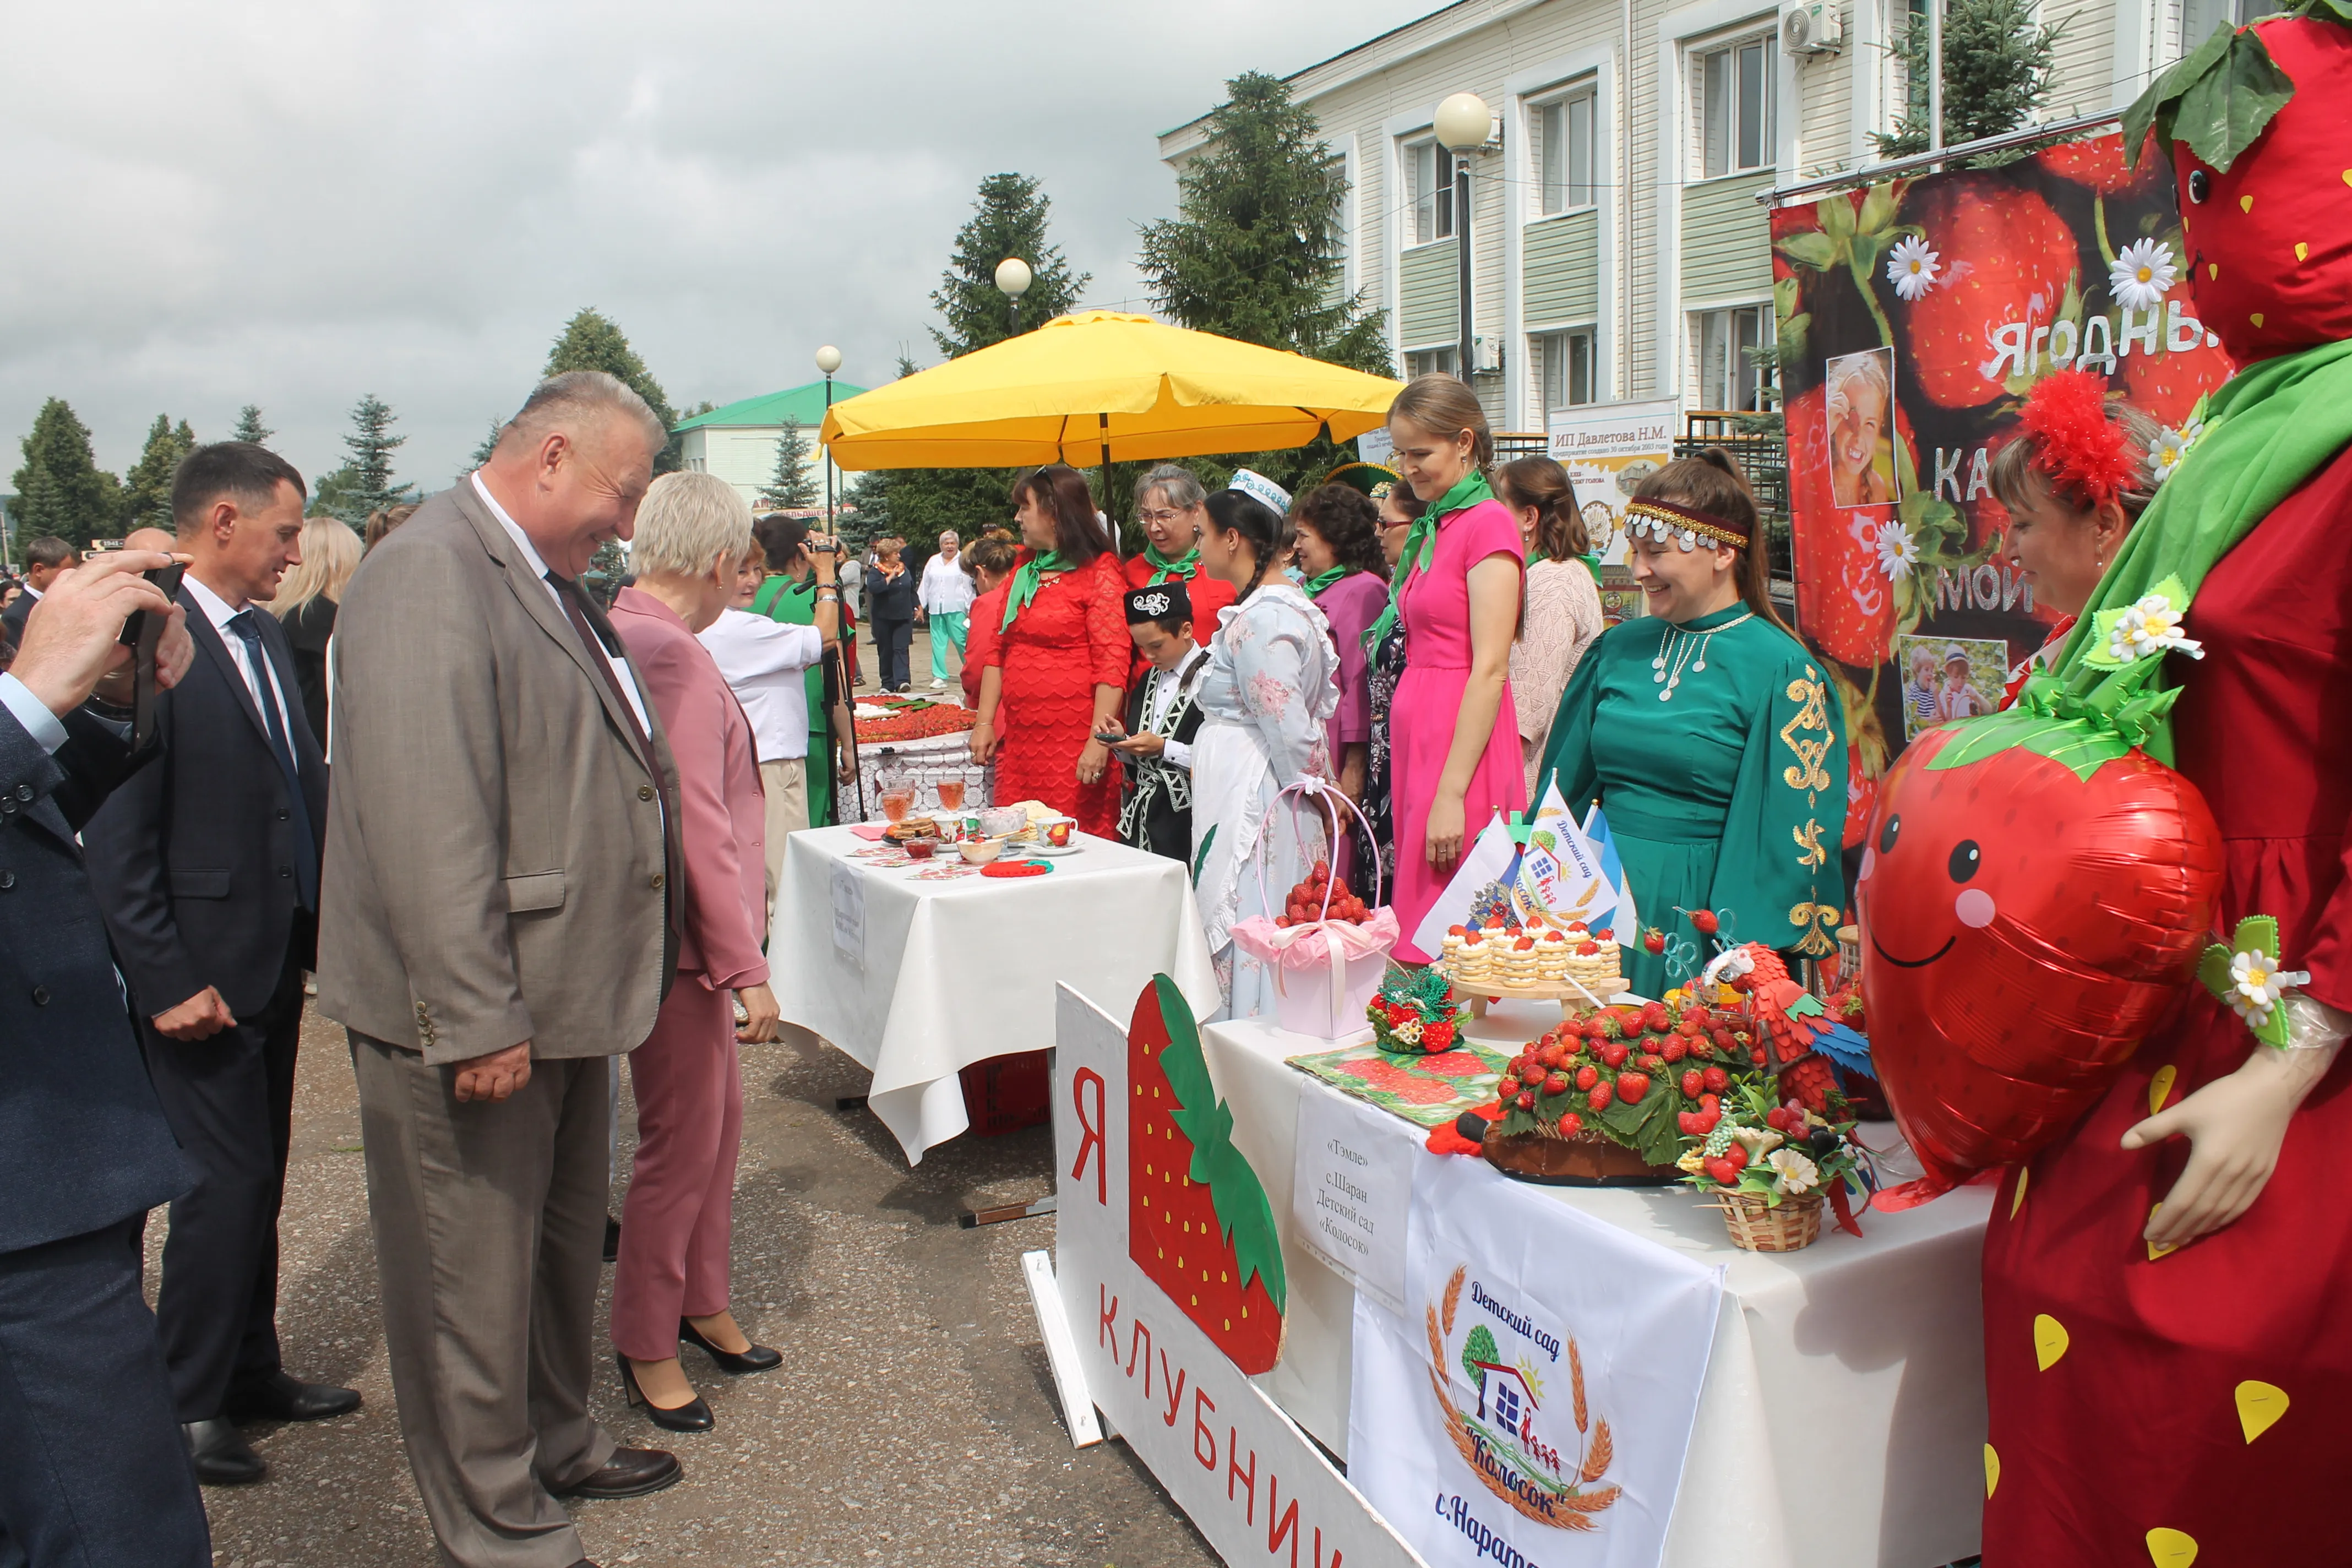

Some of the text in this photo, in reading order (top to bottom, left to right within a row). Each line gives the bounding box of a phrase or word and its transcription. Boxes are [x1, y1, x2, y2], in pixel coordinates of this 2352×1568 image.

[1552, 449, 1587, 458] предприятие
[1588, 447, 1610, 455] создано
[1618, 444, 1641, 453] октября
[1555, 425, 1667, 448] ИП Давлетова Н.М.
[1556, 820, 1592, 879] Детский сад
[1071, 1066, 1107, 1207] Я
[1327, 1138, 1368, 1168] «Тэмле»
[1316, 1188, 1375, 1236] Детский сад
[1325, 1172, 1368, 1204] с.Шаран
[1319, 1216, 1369, 1256] «Колосок»
[1471, 1281, 1560, 1363] Детский сад
[1466, 1425, 1566, 1519] "Колосок"
[1434, 1492, 1540, 1568] с.Нарат
